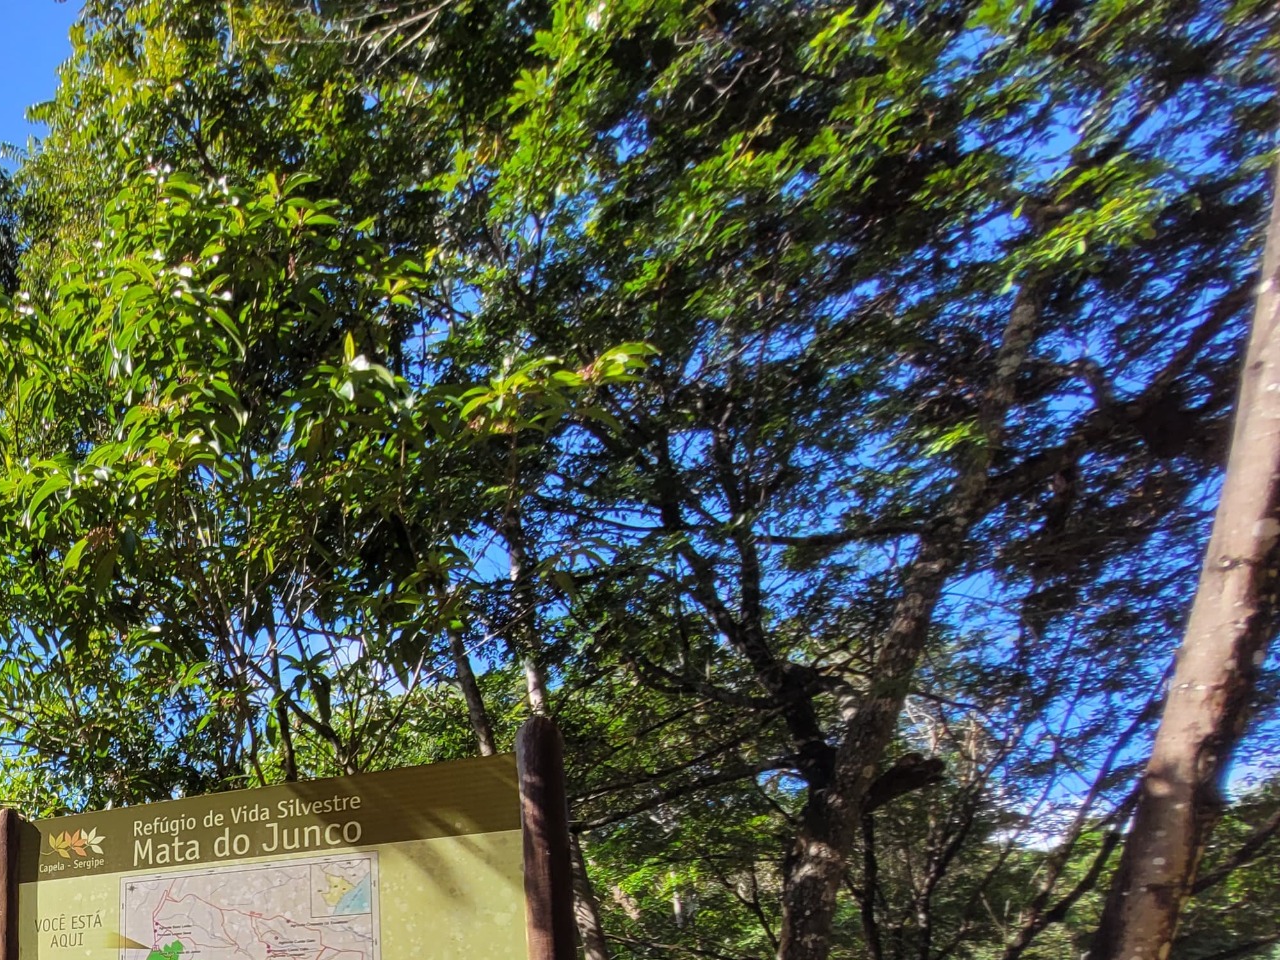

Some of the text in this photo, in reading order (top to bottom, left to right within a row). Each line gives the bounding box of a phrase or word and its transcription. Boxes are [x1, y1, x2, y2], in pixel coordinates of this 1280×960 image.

[133, 795, 361, 837] Refúgio de Vida Silvestre
[133, 820, 362, 866] Mata do Junco
[39, 861, 65, 873] Capela
[73, 857, 105, 871] Sergipe
[34, 910, 102, 933] VOCÊ ESTÁ
[50, 932, 84, 948] AQUI
